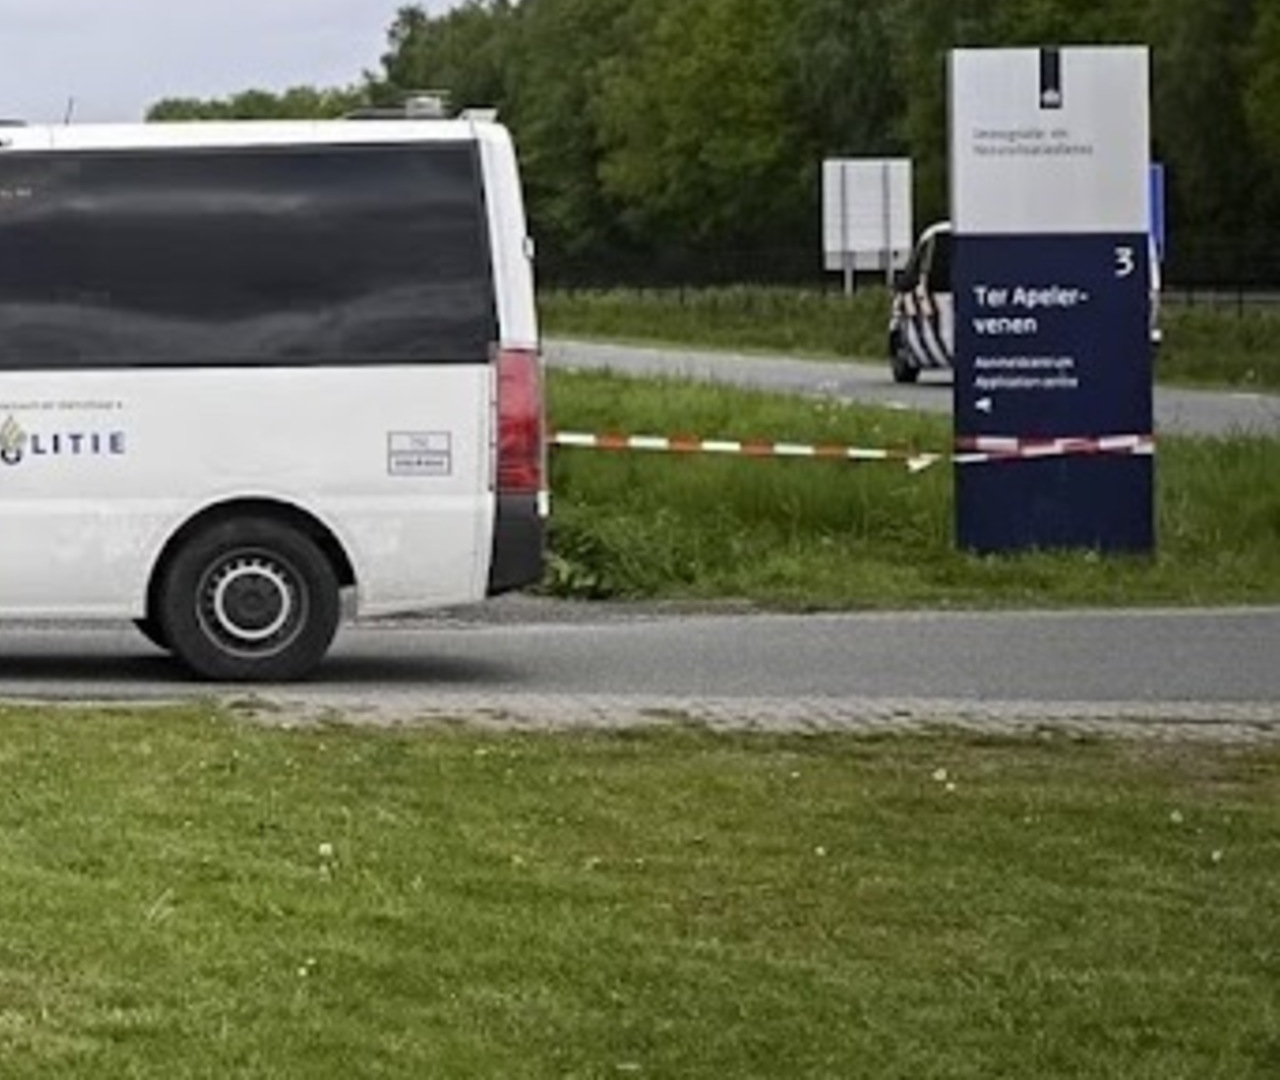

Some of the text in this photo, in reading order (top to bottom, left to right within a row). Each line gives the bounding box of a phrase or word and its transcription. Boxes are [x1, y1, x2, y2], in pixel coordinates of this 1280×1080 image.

[1113, 246, 1135, 277] 3
[972, 285, 1089, 309] Ter Apeler-
[972, 317, 1038, 335] venen
